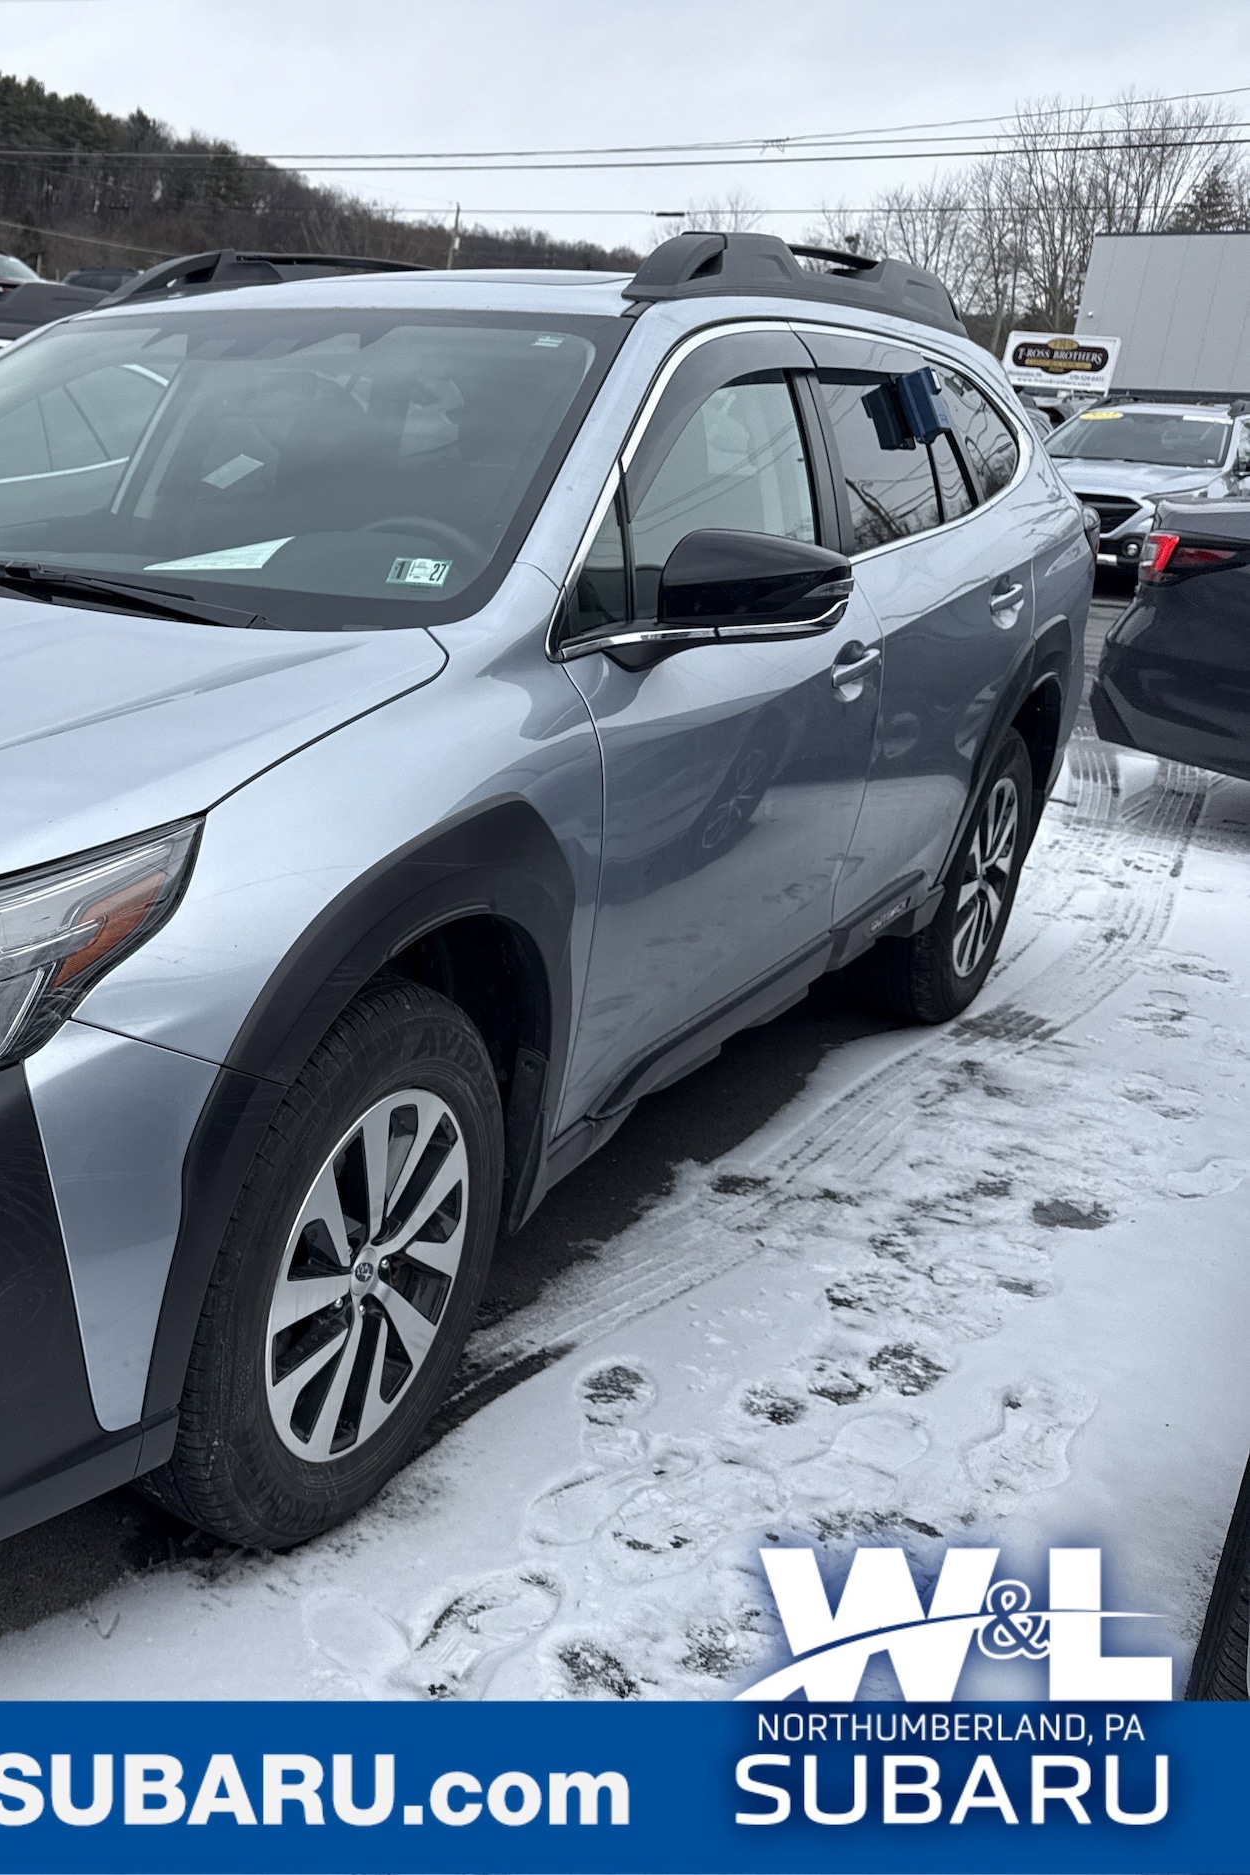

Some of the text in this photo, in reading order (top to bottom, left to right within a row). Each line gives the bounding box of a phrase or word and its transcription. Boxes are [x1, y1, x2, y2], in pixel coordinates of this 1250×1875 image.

[1052, 349, 1103, 364] BROTHERS
[395, 561, 448, 582] 1 27
[410, 1025, 483, 1074] AVID
